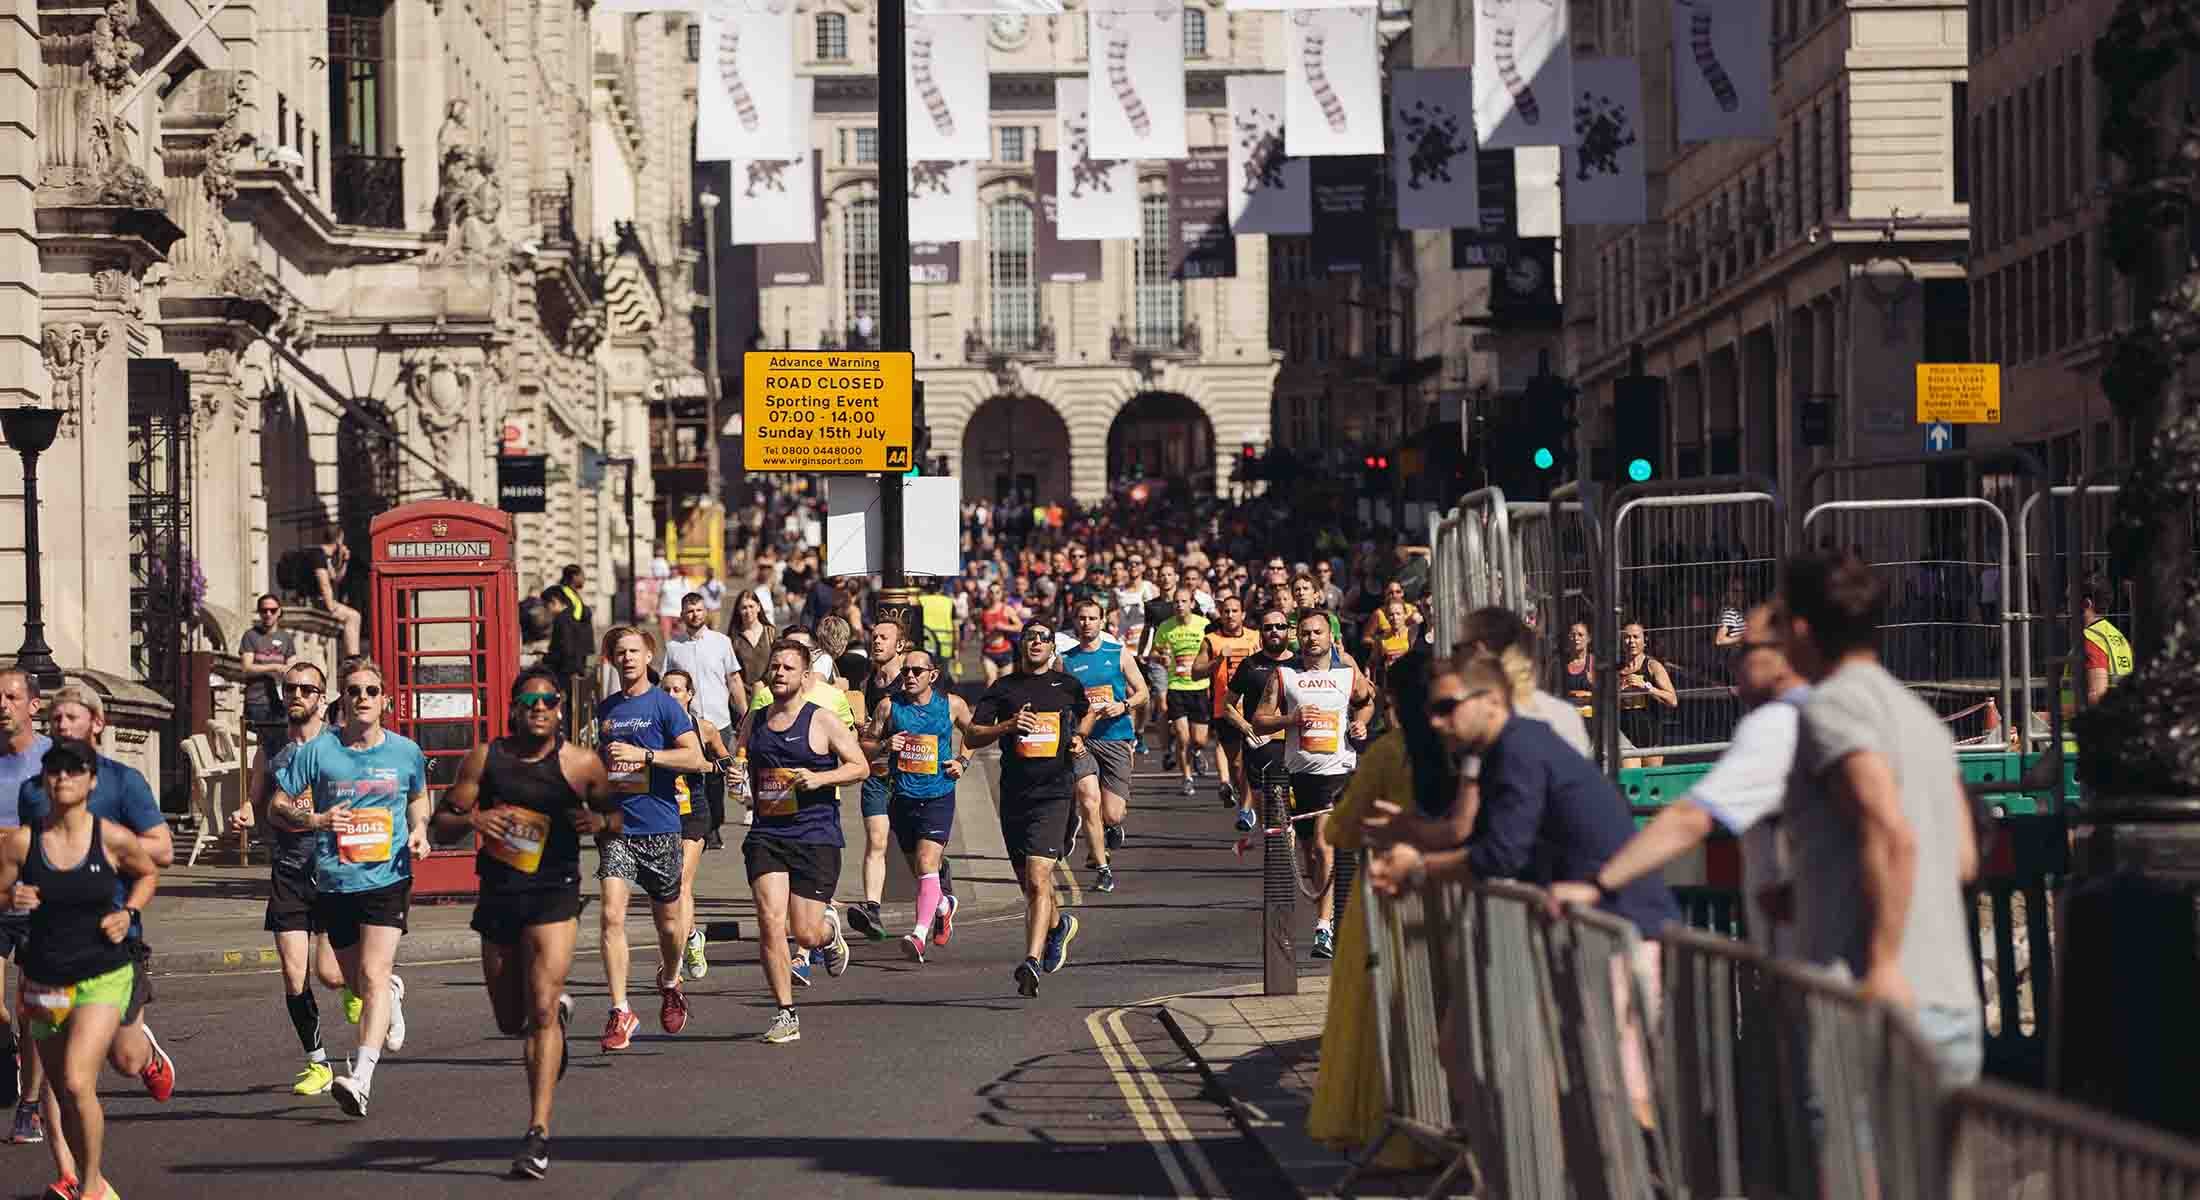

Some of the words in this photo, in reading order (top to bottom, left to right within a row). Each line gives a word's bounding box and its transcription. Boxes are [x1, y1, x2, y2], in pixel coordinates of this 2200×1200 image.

[769, 357, 823, 368] Advance
[828, 357, 880, 369] Warning
[766, 377, 812, 389] ROAD
[818, 377, 885, 389] CLOSED
[765, 395, 830, 409] Sporting
[837, 395, 879, 407] Event
[769, 411, 815, 423] 07:00
[831, 411, 875, 423] 14:00
[758, 427, 813, 440] Sunday
[819, 427, 850, 439] 15th
[856, 427, 886, 440] July
[765, 447, 778, 455] Tel
[782, 447, 809, 455] 0800
[813, 447, 862, 455] 0448000
[763, 457, 863, 465] www.virginsport.com
[888, 451, 905, 464] AA
[393, 543, 487, 556] TELEPHONE
[1298, 680, 1337, 688] GAVIN
